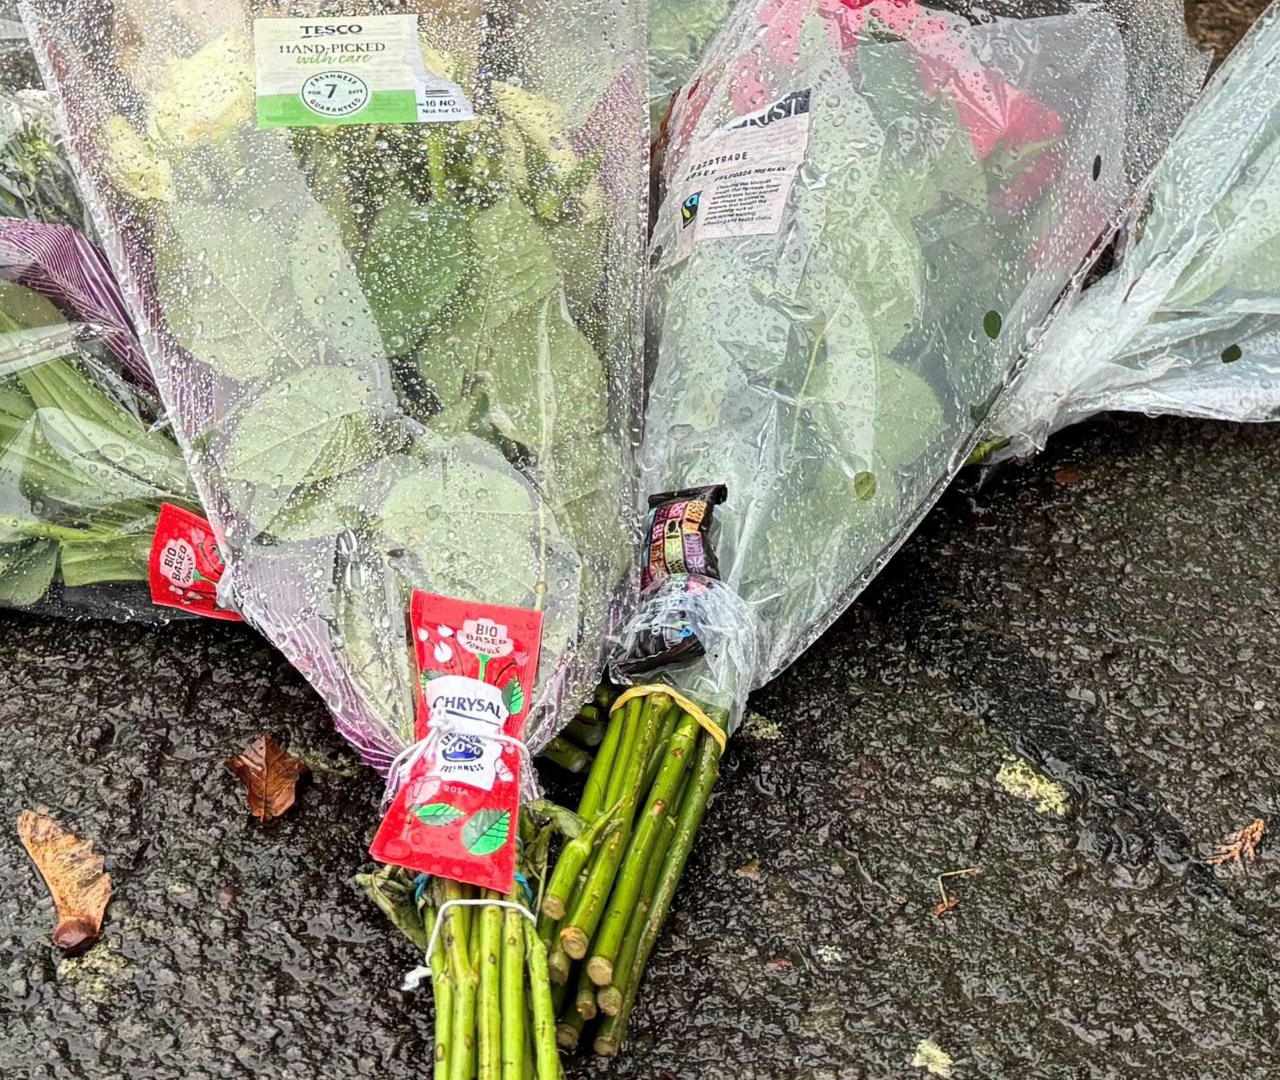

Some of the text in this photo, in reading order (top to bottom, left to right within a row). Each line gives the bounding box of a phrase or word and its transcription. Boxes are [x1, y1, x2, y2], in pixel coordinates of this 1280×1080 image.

[300, 24, 363, 36] TESCO
[280, 42, 385, 54] HAND-PICKED
[338, 54, 374, 65] care
[324, 83, 338, 99] 7
[164, 547, 177, 568] BIO
[171, 545, 187, 581] BASED
[476, 623, 498, 638] BIO
[466, 633, 507, 645] BASED
[433, 696, 501, 719] CHRYSAL
